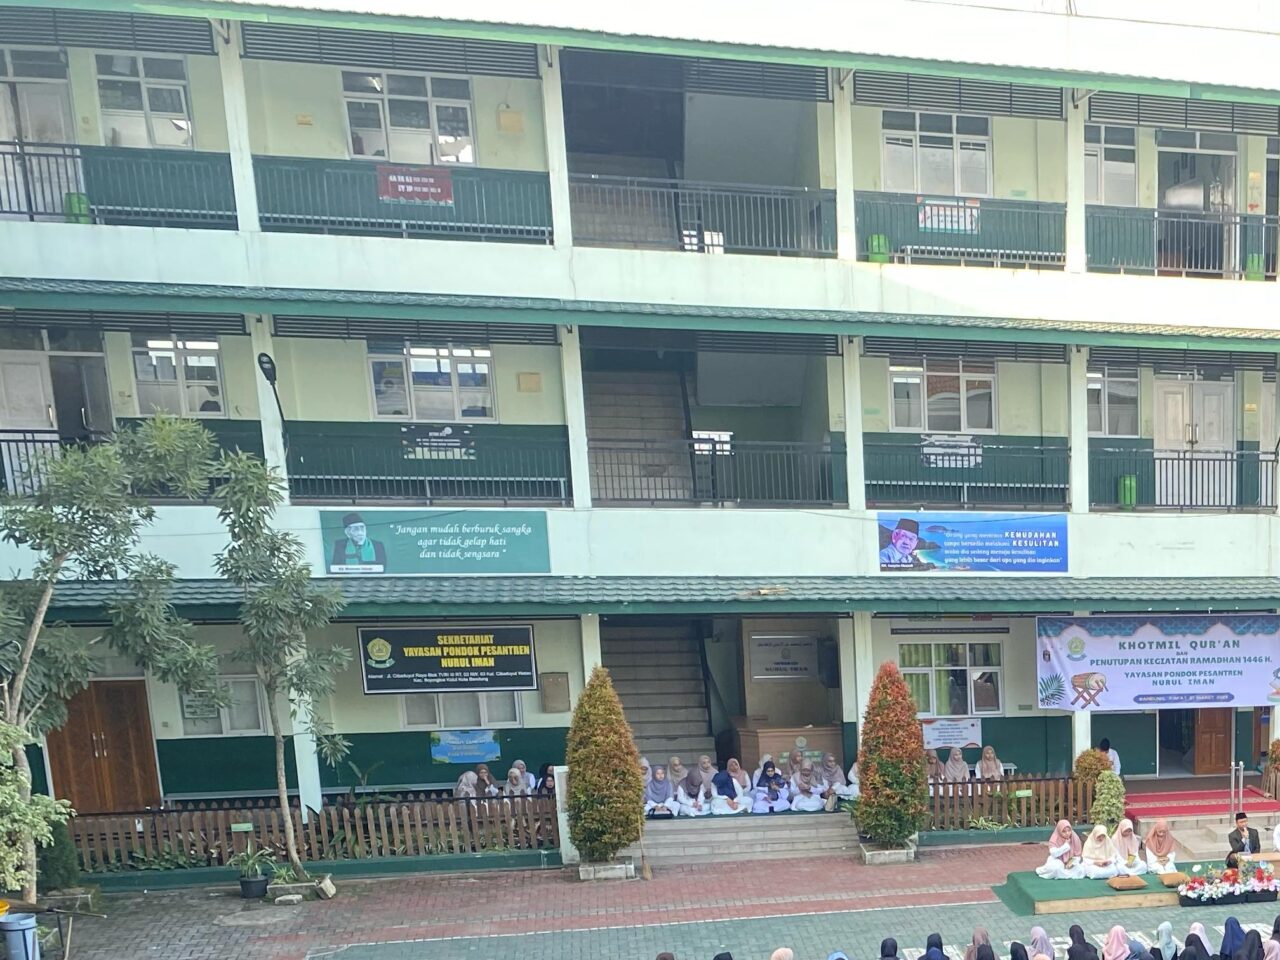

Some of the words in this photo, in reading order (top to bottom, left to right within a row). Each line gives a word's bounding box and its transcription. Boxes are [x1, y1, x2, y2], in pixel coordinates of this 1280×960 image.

[430, 523, 460, 533] mudah
[462, 523, 502, 535] berburuk
[502, 523, 532, 536] sangka
[417, 539, 438, 548] agar
[439, 536, 466, 548] tidak
[464, 536, 487, 548] gelap
[489, 536, 507, 545] hati
[419, 549, 437, 558] dan
[439, 549, 464, 560] tidak
[437, 634, 495, 645] SEKRETARIAT
[1118, 641, 1181, 650] KHOTMIL
[1189, 640, 1240, 650] QUR'AN
[402, 647, 442, 657] YAYASAN
[443, 646, 480, 656] PONDOK
[481, 645, 530, 655] PESANTREN
[441, 658, 471, 667] NURUL
[471, 657, 495, 667] IMAN
[1090, 658, 1143, 666] PENUTUPAN
[1143, 657, 1188, 665] KEGIATAN
[1189, 656, 1241, 664] RAMADHAN
[1164, 670, 1197, 678] PONDOK
